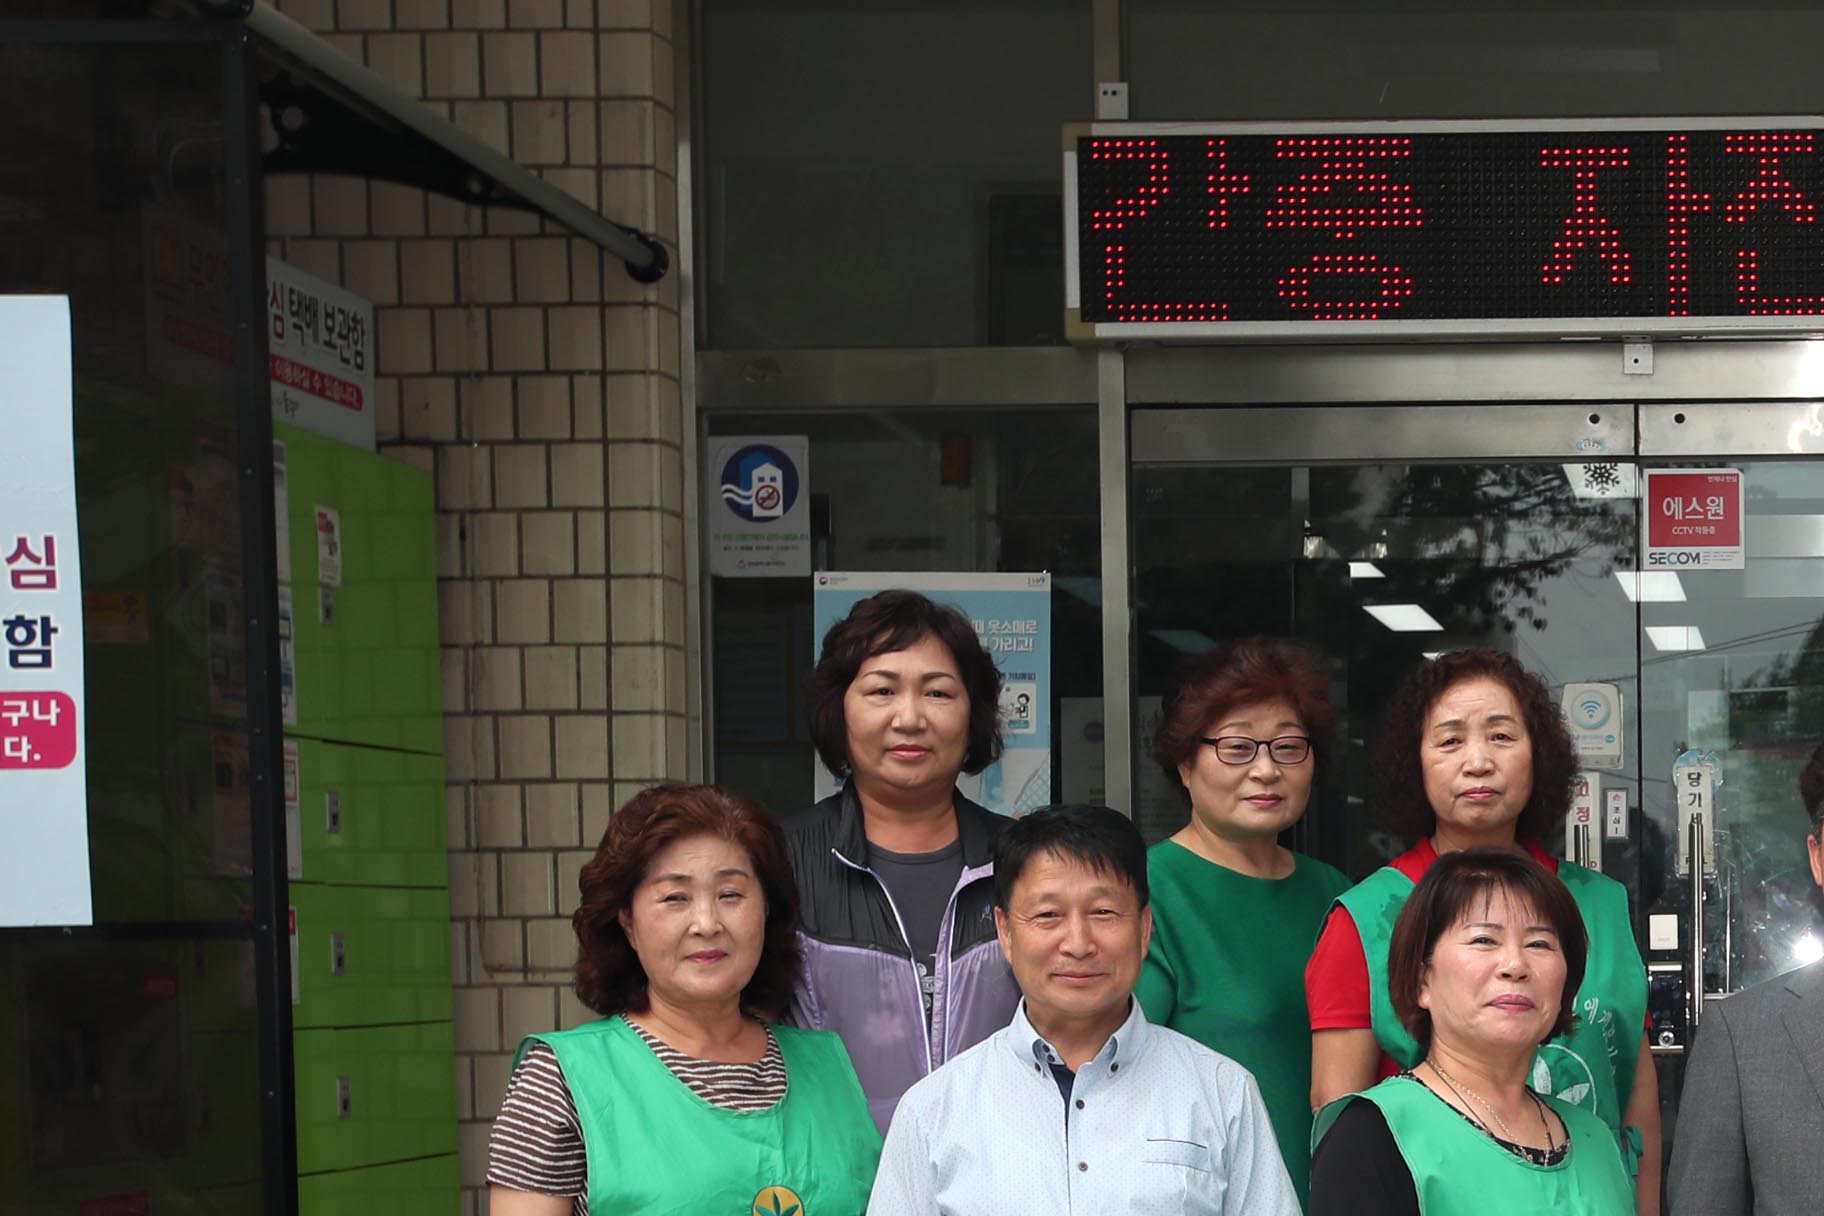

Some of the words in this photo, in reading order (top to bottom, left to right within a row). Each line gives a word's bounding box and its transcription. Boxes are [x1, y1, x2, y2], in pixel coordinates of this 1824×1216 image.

[323, 303, 365, 371] 보관함
[1663, 496, 1724, 520] 에스원
[1672, 526, 1694, 535] CCTV
[5, 534, 57, 590] 심
[1649, 552, 1701, 564] SECOM
[3, 614, 58, 670] 함
